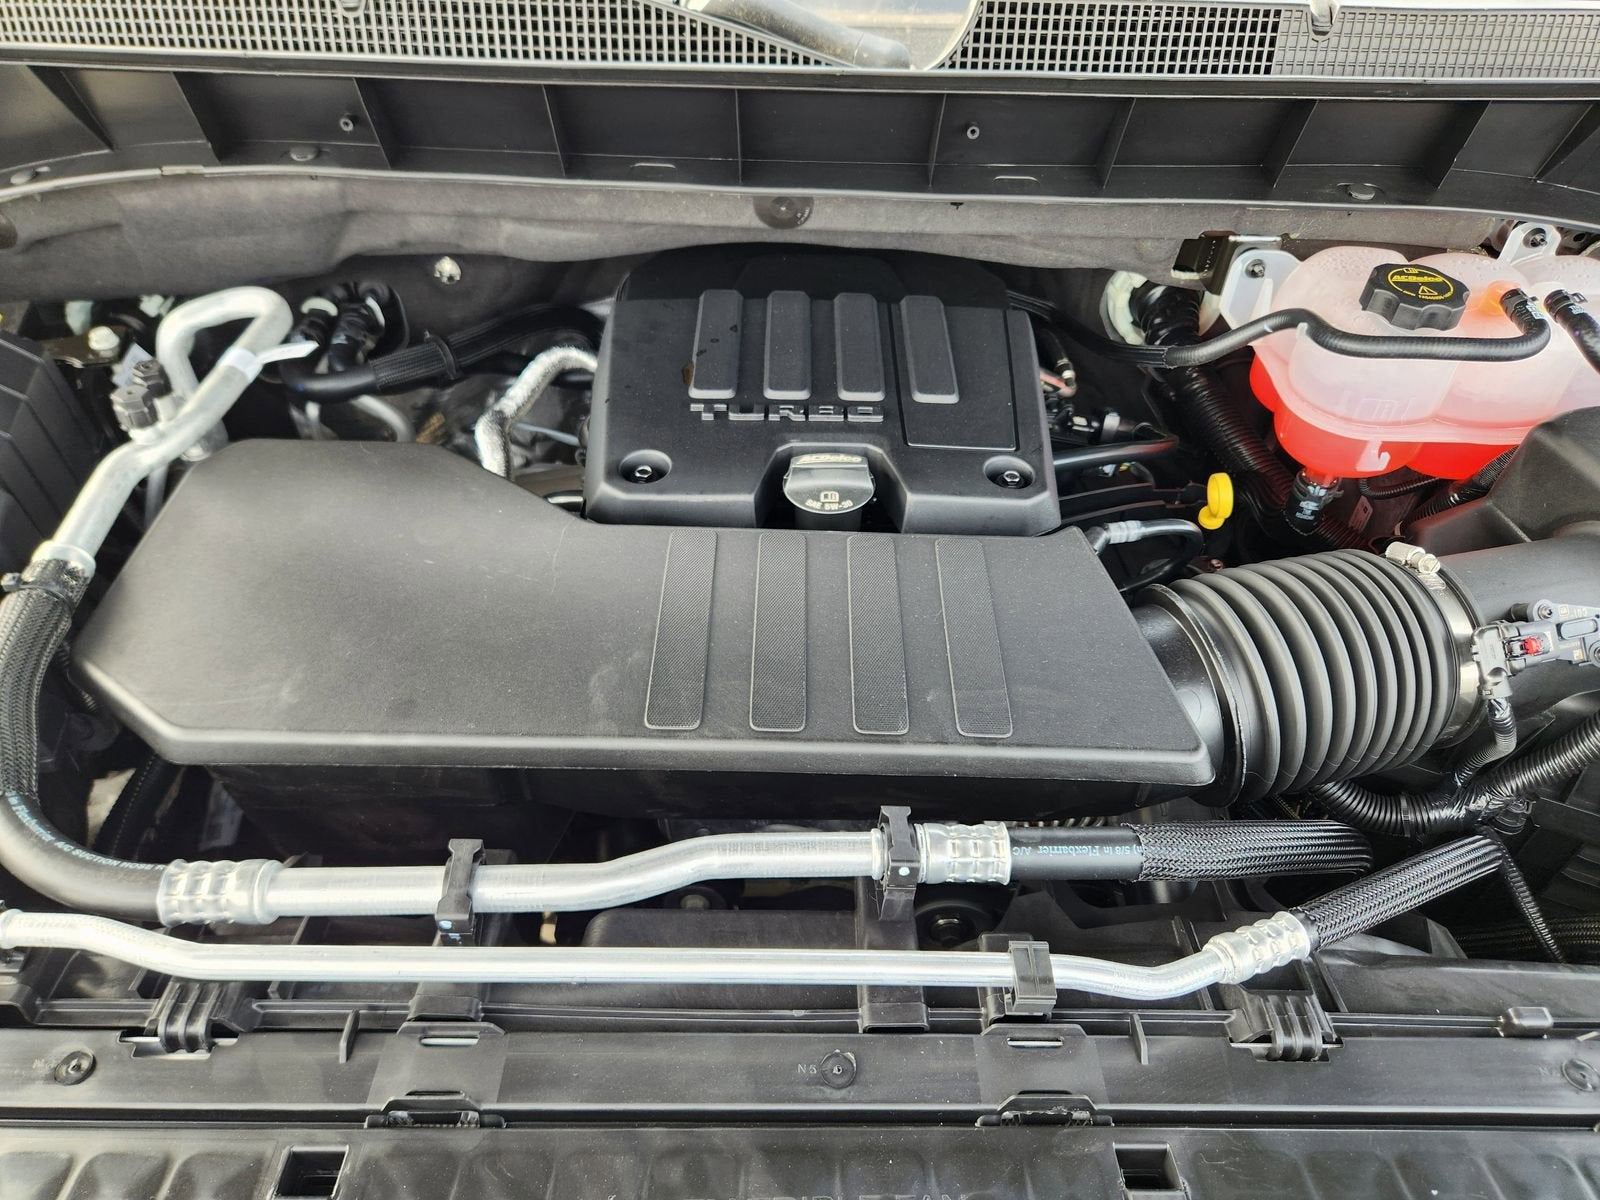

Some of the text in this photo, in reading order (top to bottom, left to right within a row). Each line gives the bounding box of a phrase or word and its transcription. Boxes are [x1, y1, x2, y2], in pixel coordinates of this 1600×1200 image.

[689, 403, 884, 422] TURBO
[805, 498, 822, 509] SAE
[54, 841, 74, 852] A/C
[72, 849, 121, 866] SUCTION
[120, 861, 155, 870] HOSE
[1012, 846, 1031, 855] A/C
[1037, 845, 1100, 856] Flexbarrier
[1103, 846, 1113, 855] in
[1115, 846, 1131, 855] 5/8
